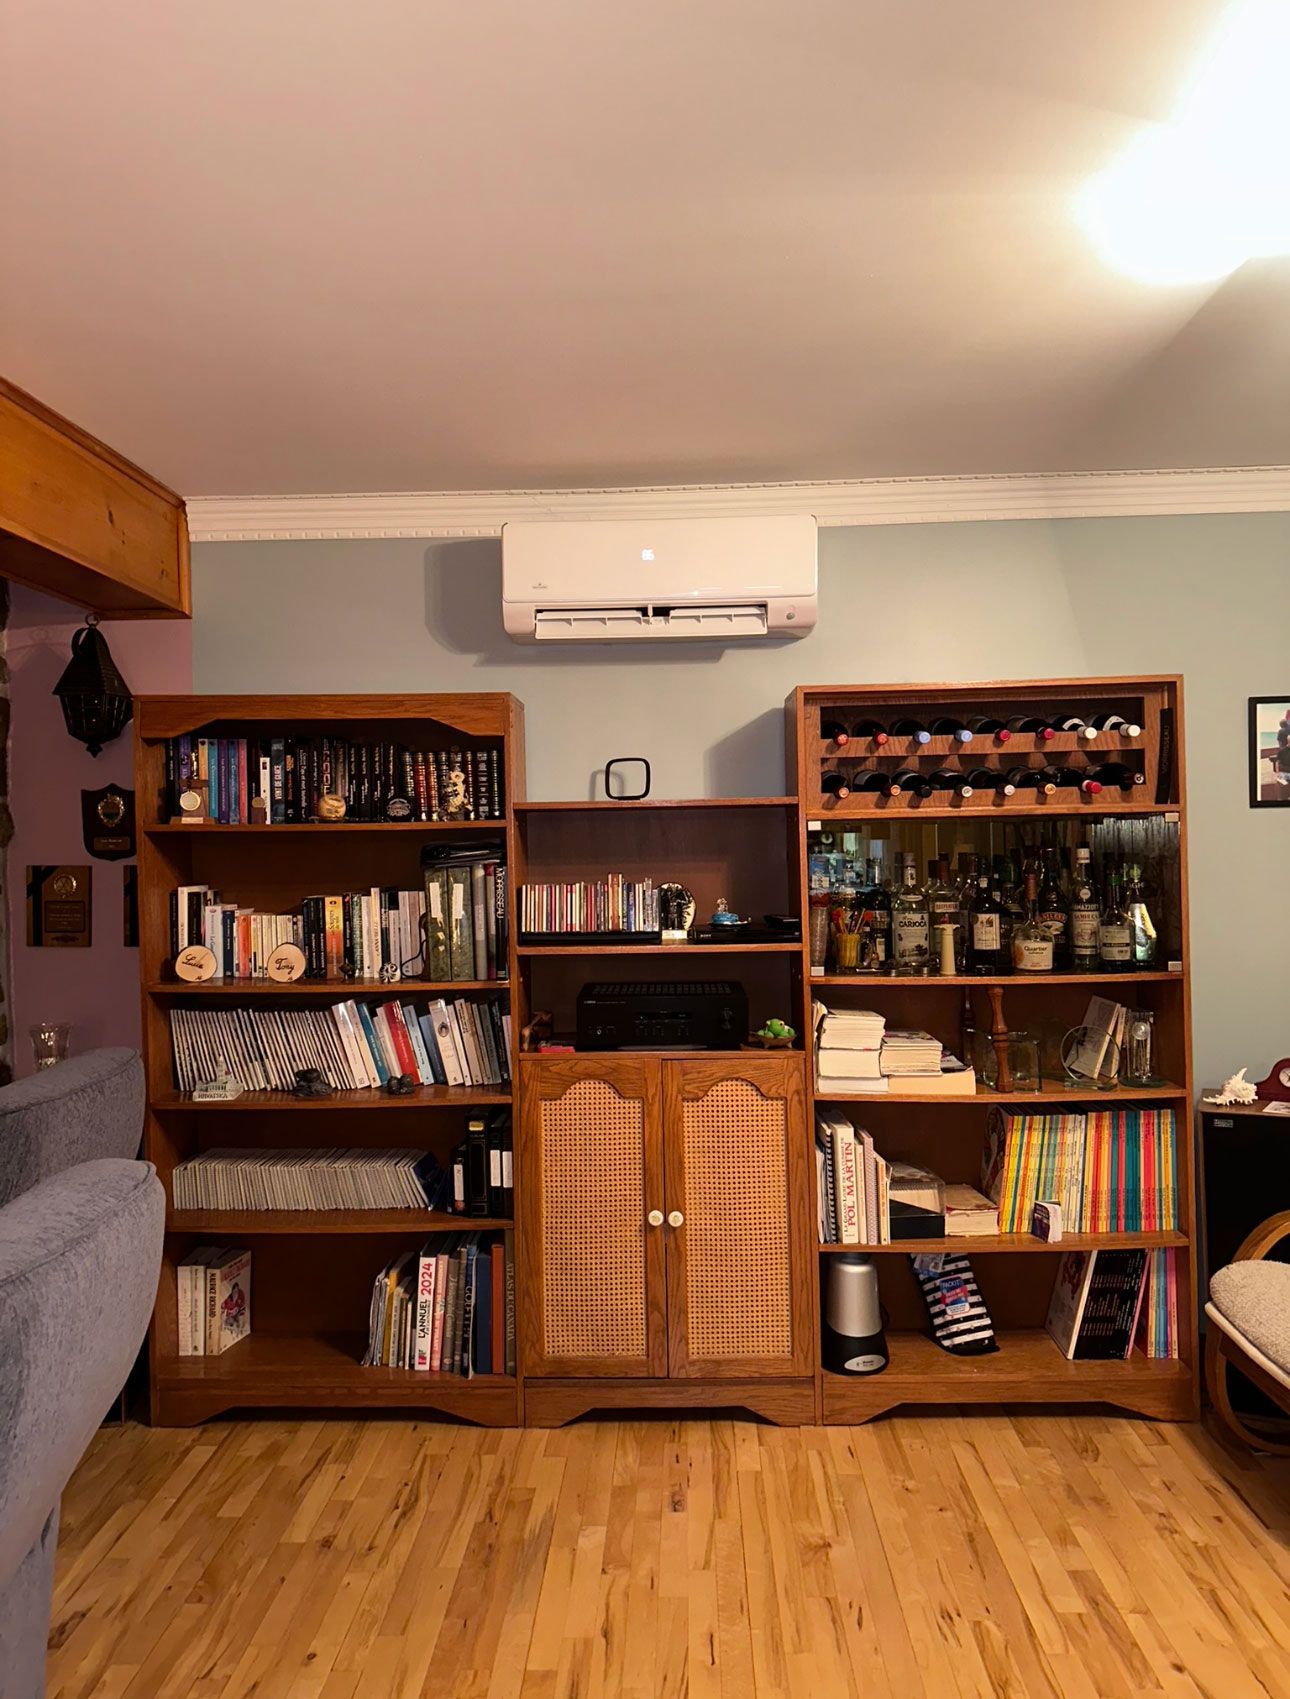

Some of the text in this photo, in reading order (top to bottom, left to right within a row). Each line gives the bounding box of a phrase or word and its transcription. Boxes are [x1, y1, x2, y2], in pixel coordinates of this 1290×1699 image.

[495, 867, 505, 919] MORRISSEAU
[898, 919, 927, 928] CARIOCA
[275, 957, 296, 975] Tony
[844, 1142, 856, 1226] POL MARTIN
[208, 1272, 217, 1295] MAURICE
[421, 1263, 433, 1296] 2024
[506, 1261, 514, 1290] ATLAS
[208, 1296, 217, 1319] RICHARD
[417, 1299, 429, 1339] L'ANNUEL
[506, 1304, 514, 1341] CANADA
